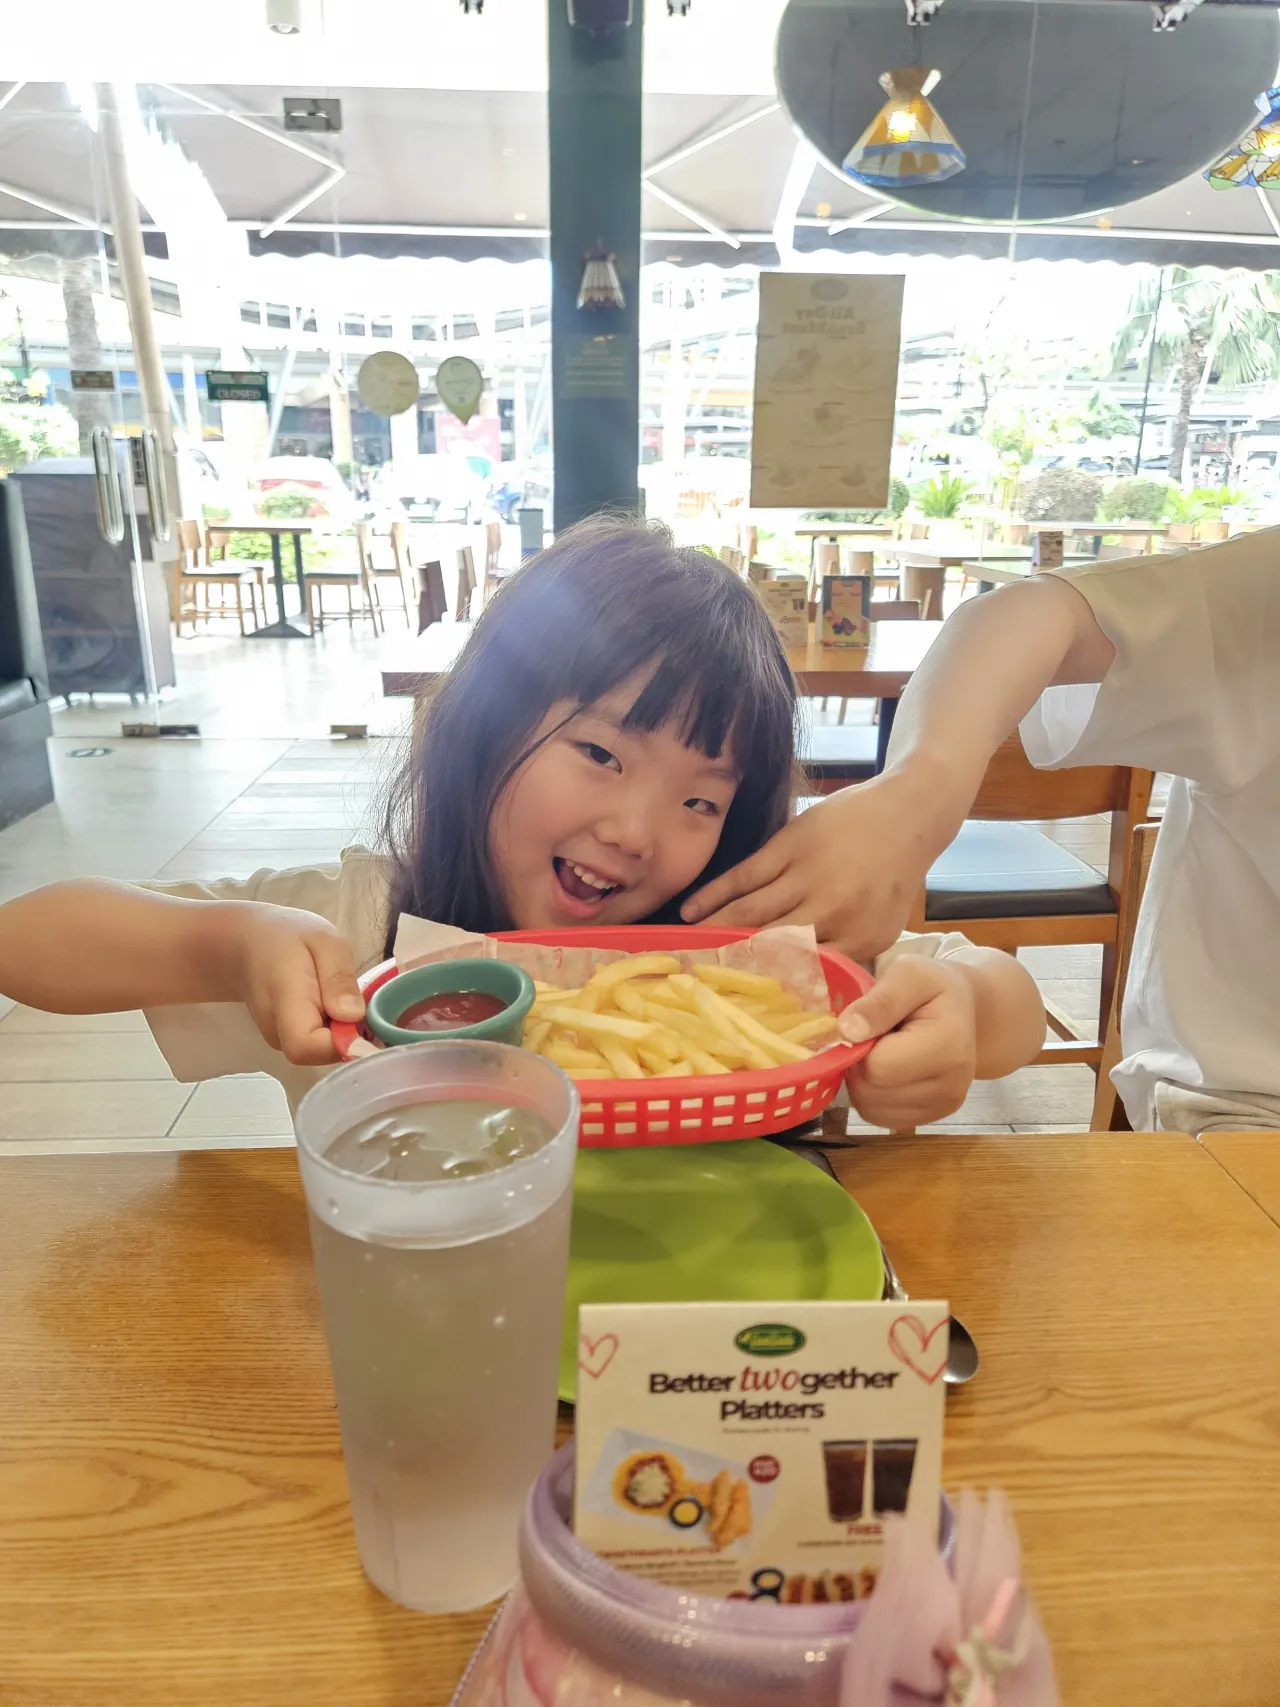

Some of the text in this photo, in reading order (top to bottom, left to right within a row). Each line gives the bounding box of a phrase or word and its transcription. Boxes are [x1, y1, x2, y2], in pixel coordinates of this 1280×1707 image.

[216, 387, 262, 400] CLOSED
[649, 1365, 899, 1395] Better twogether
[720, 1399, 825, 1421] Platters
